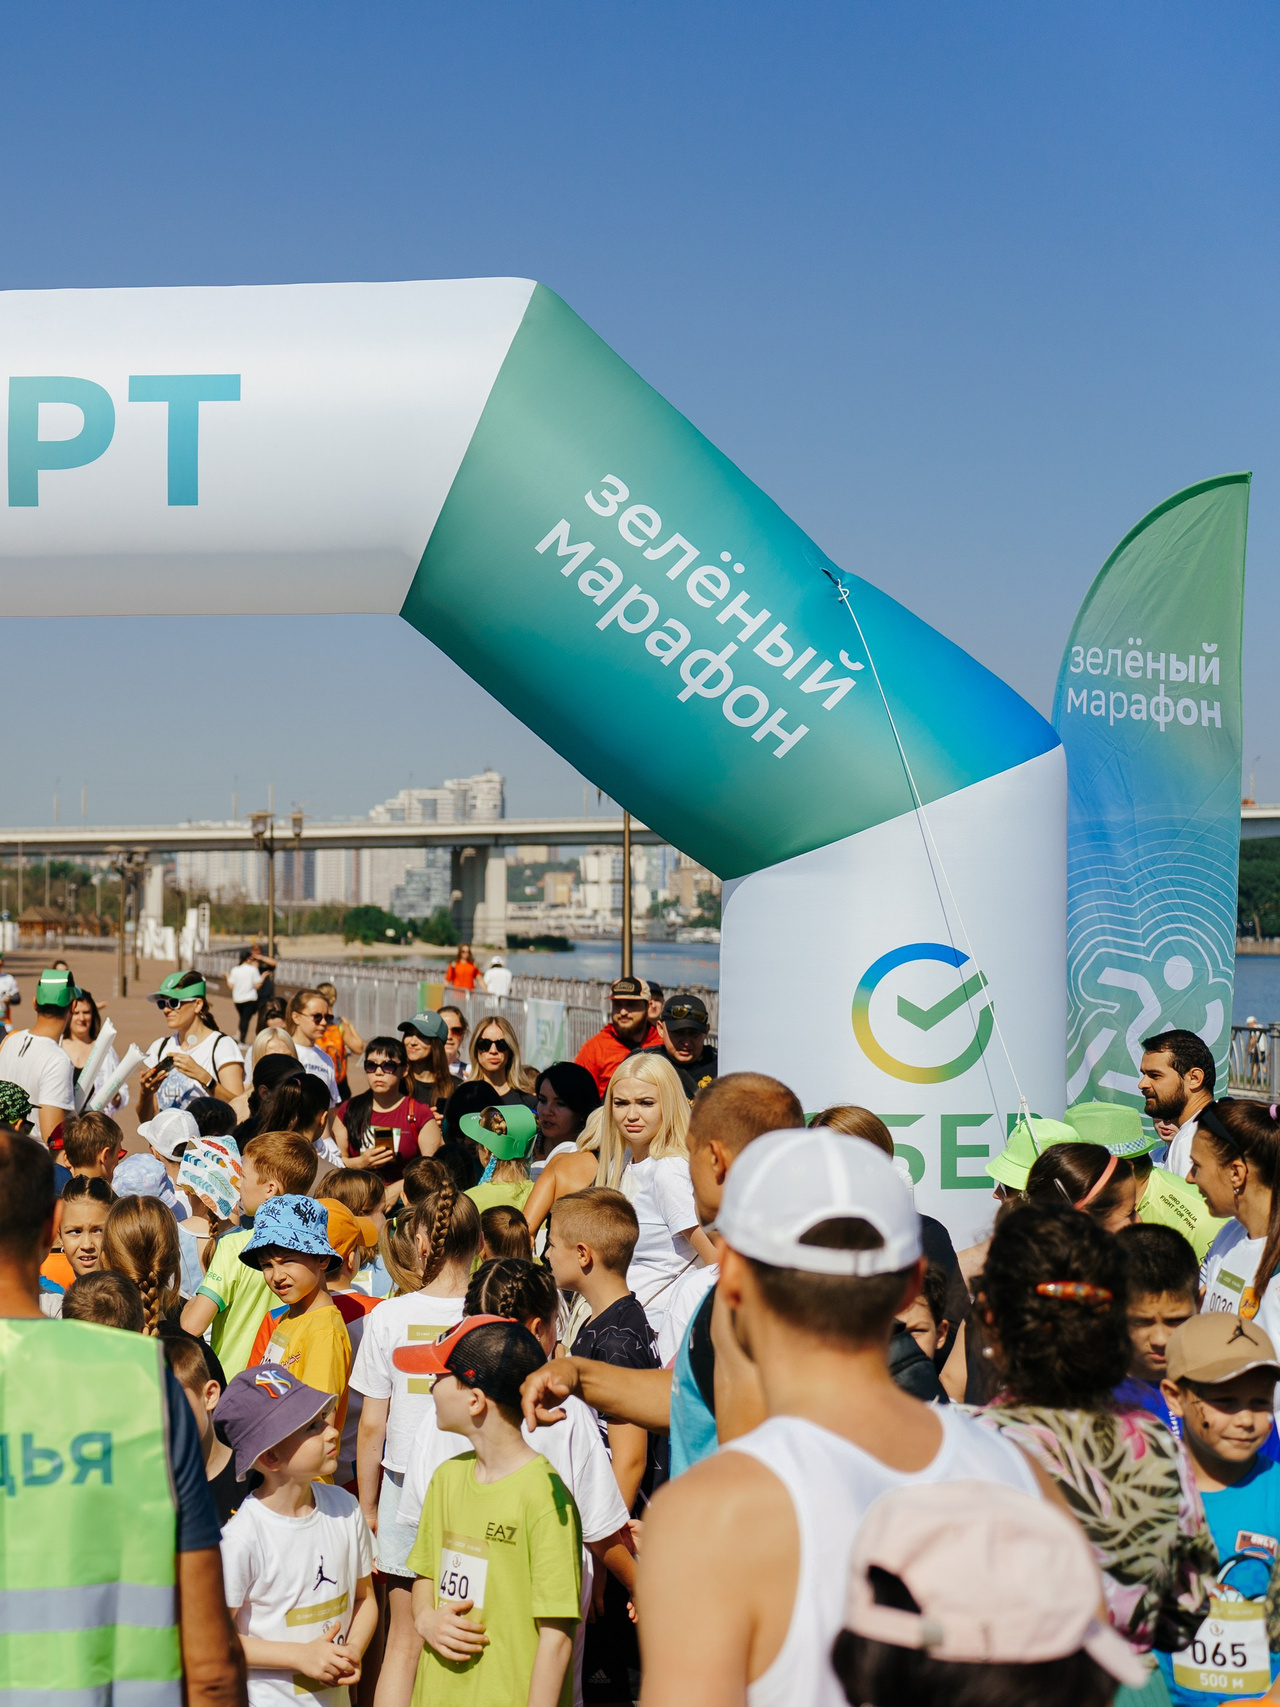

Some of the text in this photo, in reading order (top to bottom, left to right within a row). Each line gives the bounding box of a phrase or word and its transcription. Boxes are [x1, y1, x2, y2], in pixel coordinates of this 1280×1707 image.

[584, 473, 865, 711] зелёный
[534, 518, 810, 759] марафон
[1070, 637, 1220, 685] зелёный
[1067, 683, 1222, 732] марафон
[1160, 1195, 1175, 1209] FIGHT
[1174, 1207, 1185, 1219] FOR
[1183, 1216, 1196, 1231] PINK
[1168, 1193, 1181, 1205] GIRO
[486, 1522, 517, 1540] EA7
[440, 1570, 469, 1600] 450
[1191, 1639, 1248, 1668] 065
[1200, 1672, 1228, 1688] 500
